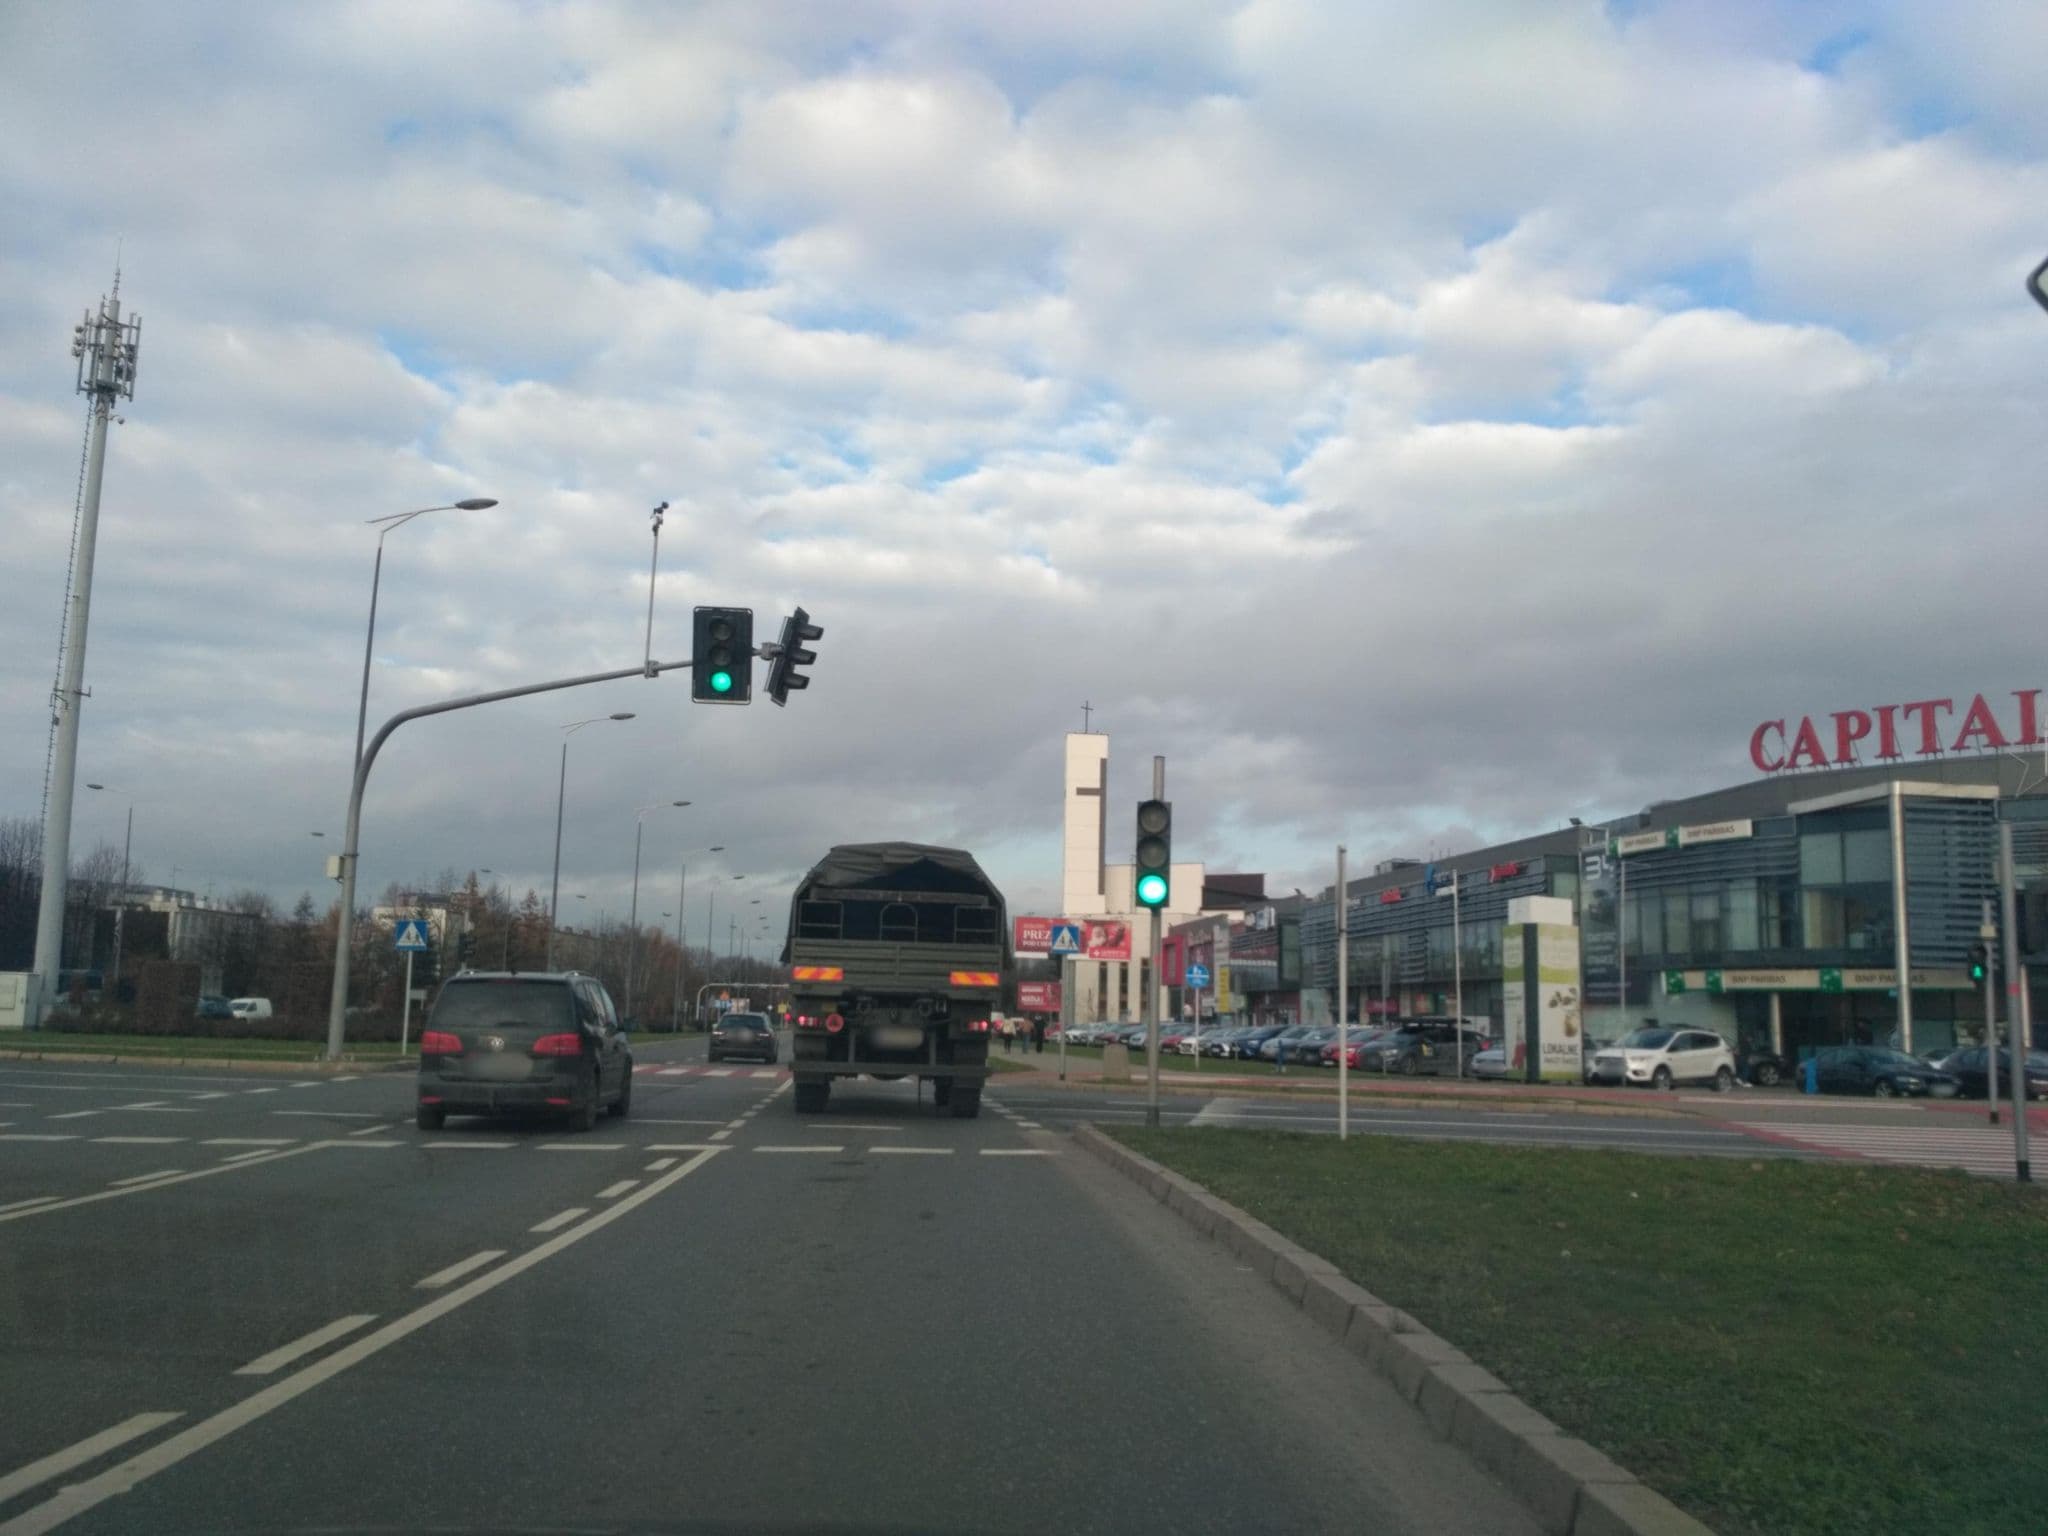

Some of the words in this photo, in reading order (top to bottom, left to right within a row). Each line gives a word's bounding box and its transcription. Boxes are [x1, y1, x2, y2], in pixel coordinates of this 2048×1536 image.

[1703, 824, 1736, 836] PARIBAS
[1023, 929, 1051, 939] PREZ
[1732, 975, 1749, 984] BNP
[1751, 975, 1787, 985] PARIBAS
[1855, 974, 1876, 984] BNP
